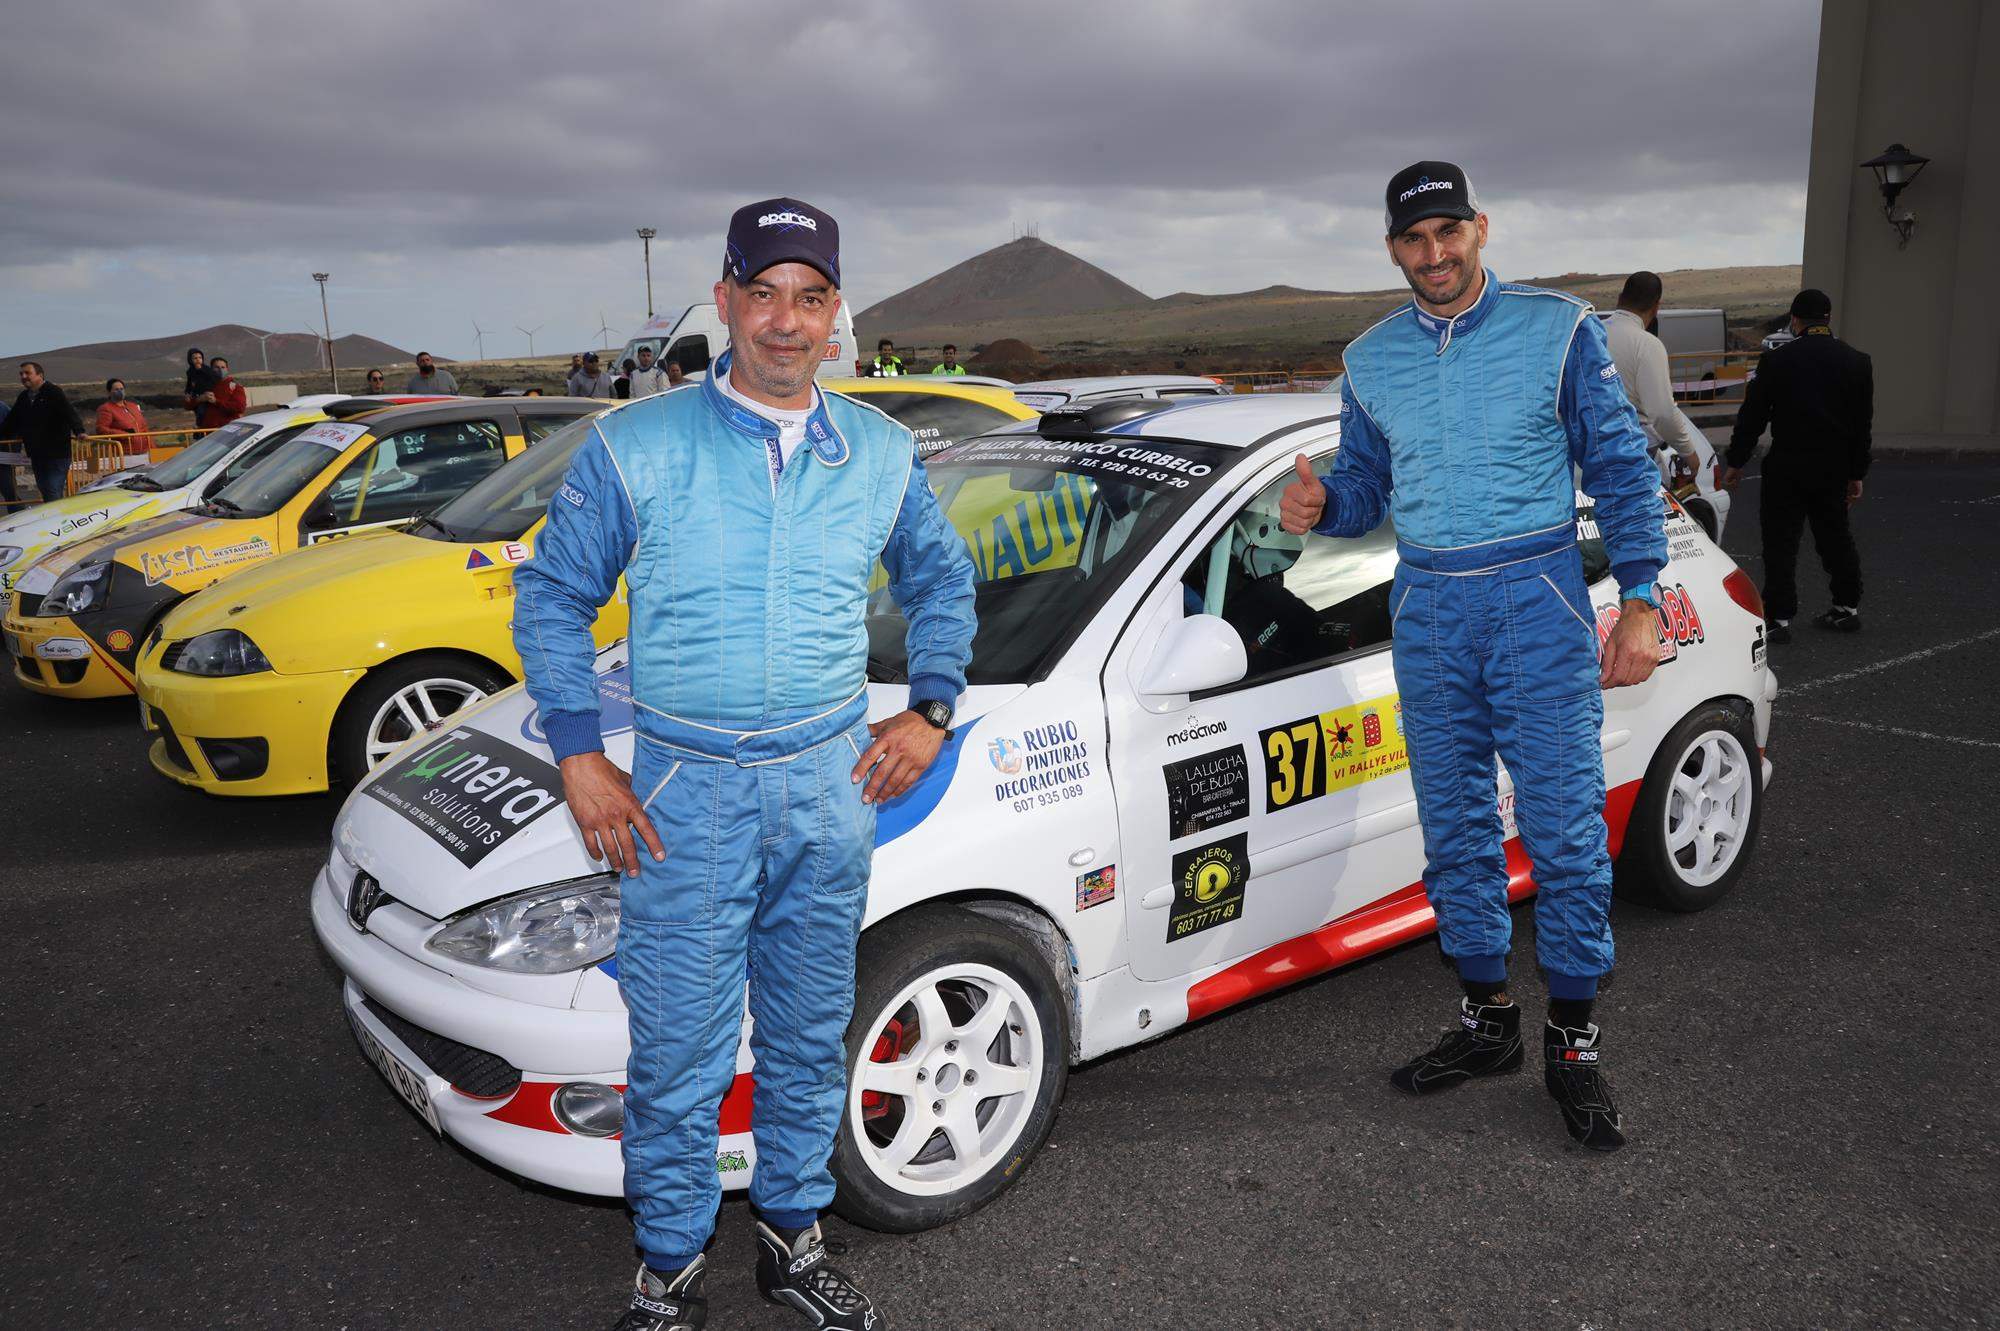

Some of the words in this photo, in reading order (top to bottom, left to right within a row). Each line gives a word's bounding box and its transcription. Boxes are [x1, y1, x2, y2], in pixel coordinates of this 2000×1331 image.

[758, 212, 817, 231] sparco
[918, 438, 953, 453] ntana
[1020, 439, 1118, 455] MECANICO
[1117, 447, 1212, 477] CURBELO
[1042, 454, 1071, 464] UGA
[1100, 461, 1128, 473] 928
[1127, 466, 1148, 477] 83
[1147, 470, 1169, 482] 63
[1167, 477, 1190, 489] 20
[1575, 513, 1601, 541] rtín
[213, 541, 270, 558] RESTAURANTE
[505, 543, 526, 561] E
[1023, 719, 1078, 752] RUBIO
[1025, 741, 1087, 772] PINTURAS
[1185, 765, 1203, 781] LA
[1202, 754, 1245, 777] LUCHA
[1267, 721, 1319, 806] 37
[1334, 767, 1345, 780] VI
[1349, 754, 1387, 775] RALLYE
[1384, 765, 1393, 775] de
[1393, 761, 1407, 772] abril
[995, 761, 1091, 802] DECORACIONES
[1190, 780, 1209, 796] DE
[1209, 770, 1244, 791] BUDA
[1013, 797, 1034, 813] 607
[1037, 790, 1060, 806] 935
[1062, 784, 1083, 800] 089
[422, 788, 502, 845] solutions
[436, 825, 449, 836] 606
[445, 832, 459, 844] 500
[454, 839, 469, 852] 816
[1184, 847, 1233, 898] CERRAJEROS
[1176, 917, 1194, 935] 603
[1195, 912, 1208, 929] 77
[1209, 907, 1222, 924] 77
[1222, 903, 1235, 919] 49
[1577, 1050, 1600, 1062] RRS
[394, 1059, 430, 1119] BLP
